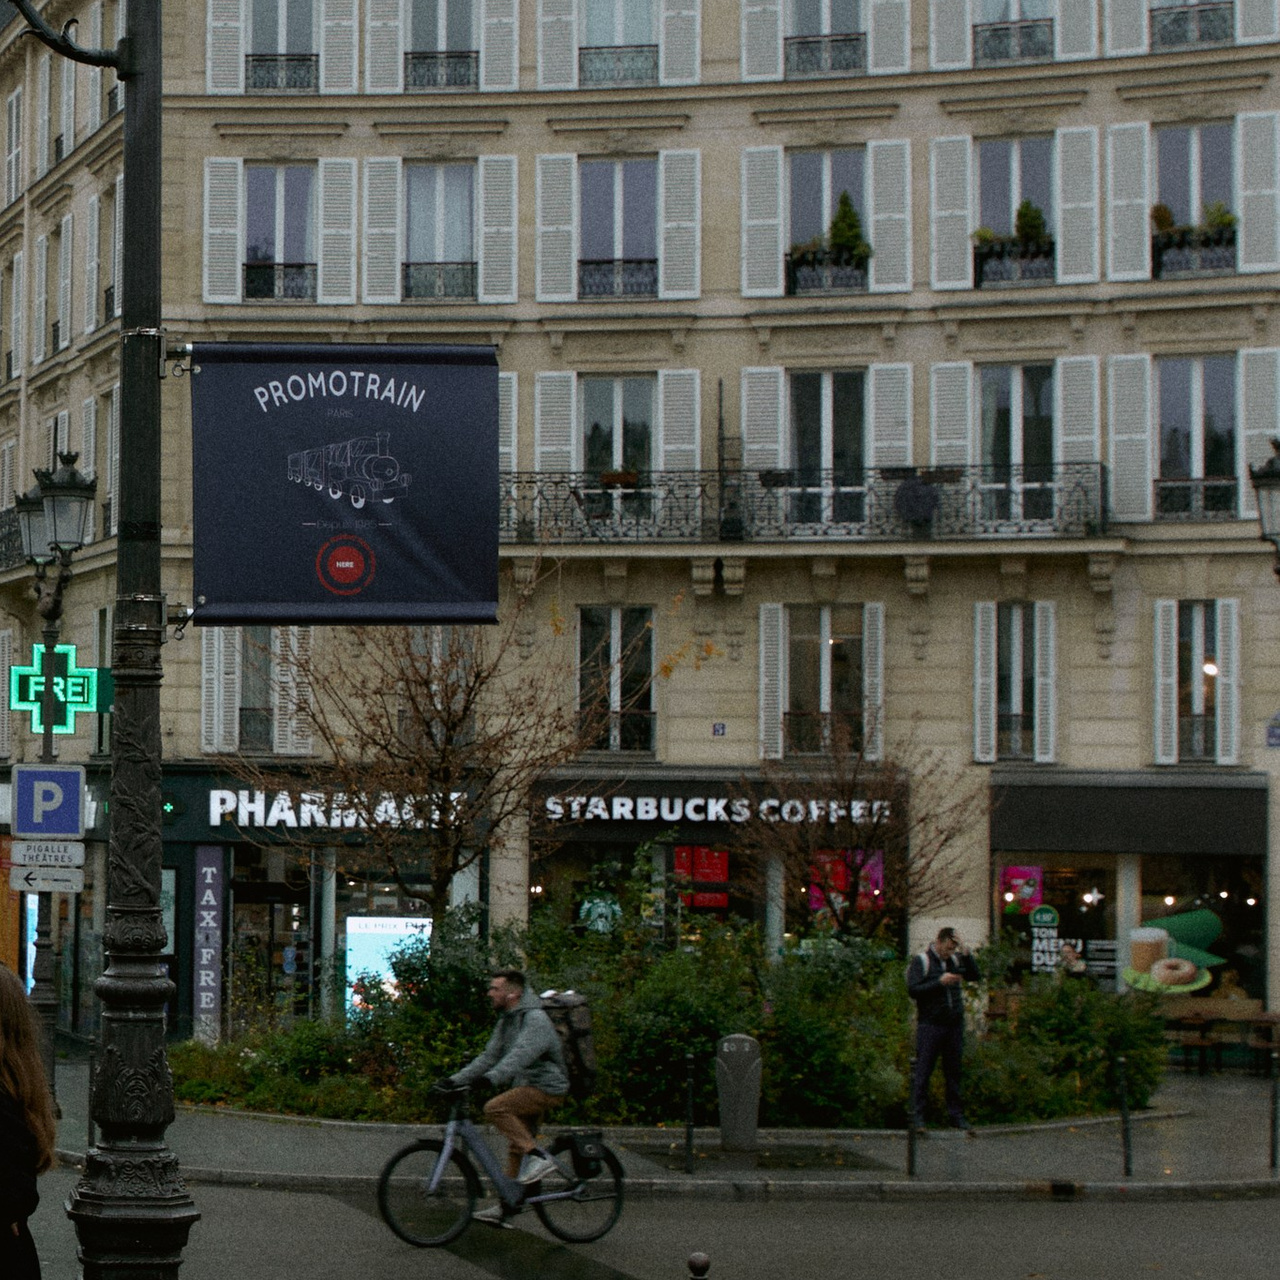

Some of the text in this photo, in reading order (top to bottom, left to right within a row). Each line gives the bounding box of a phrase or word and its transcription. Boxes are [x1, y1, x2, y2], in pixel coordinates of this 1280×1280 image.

[253, 370, 426, 412] PROMOTRAIN
[33, 781, 64, 823] P
[545, 796, 751, 822] STARBUCKS
[26, 845, 69, 853] PIGALLE
[200, 867, 219, 928] TAX
[1031, 927, 1059, 938] TON
